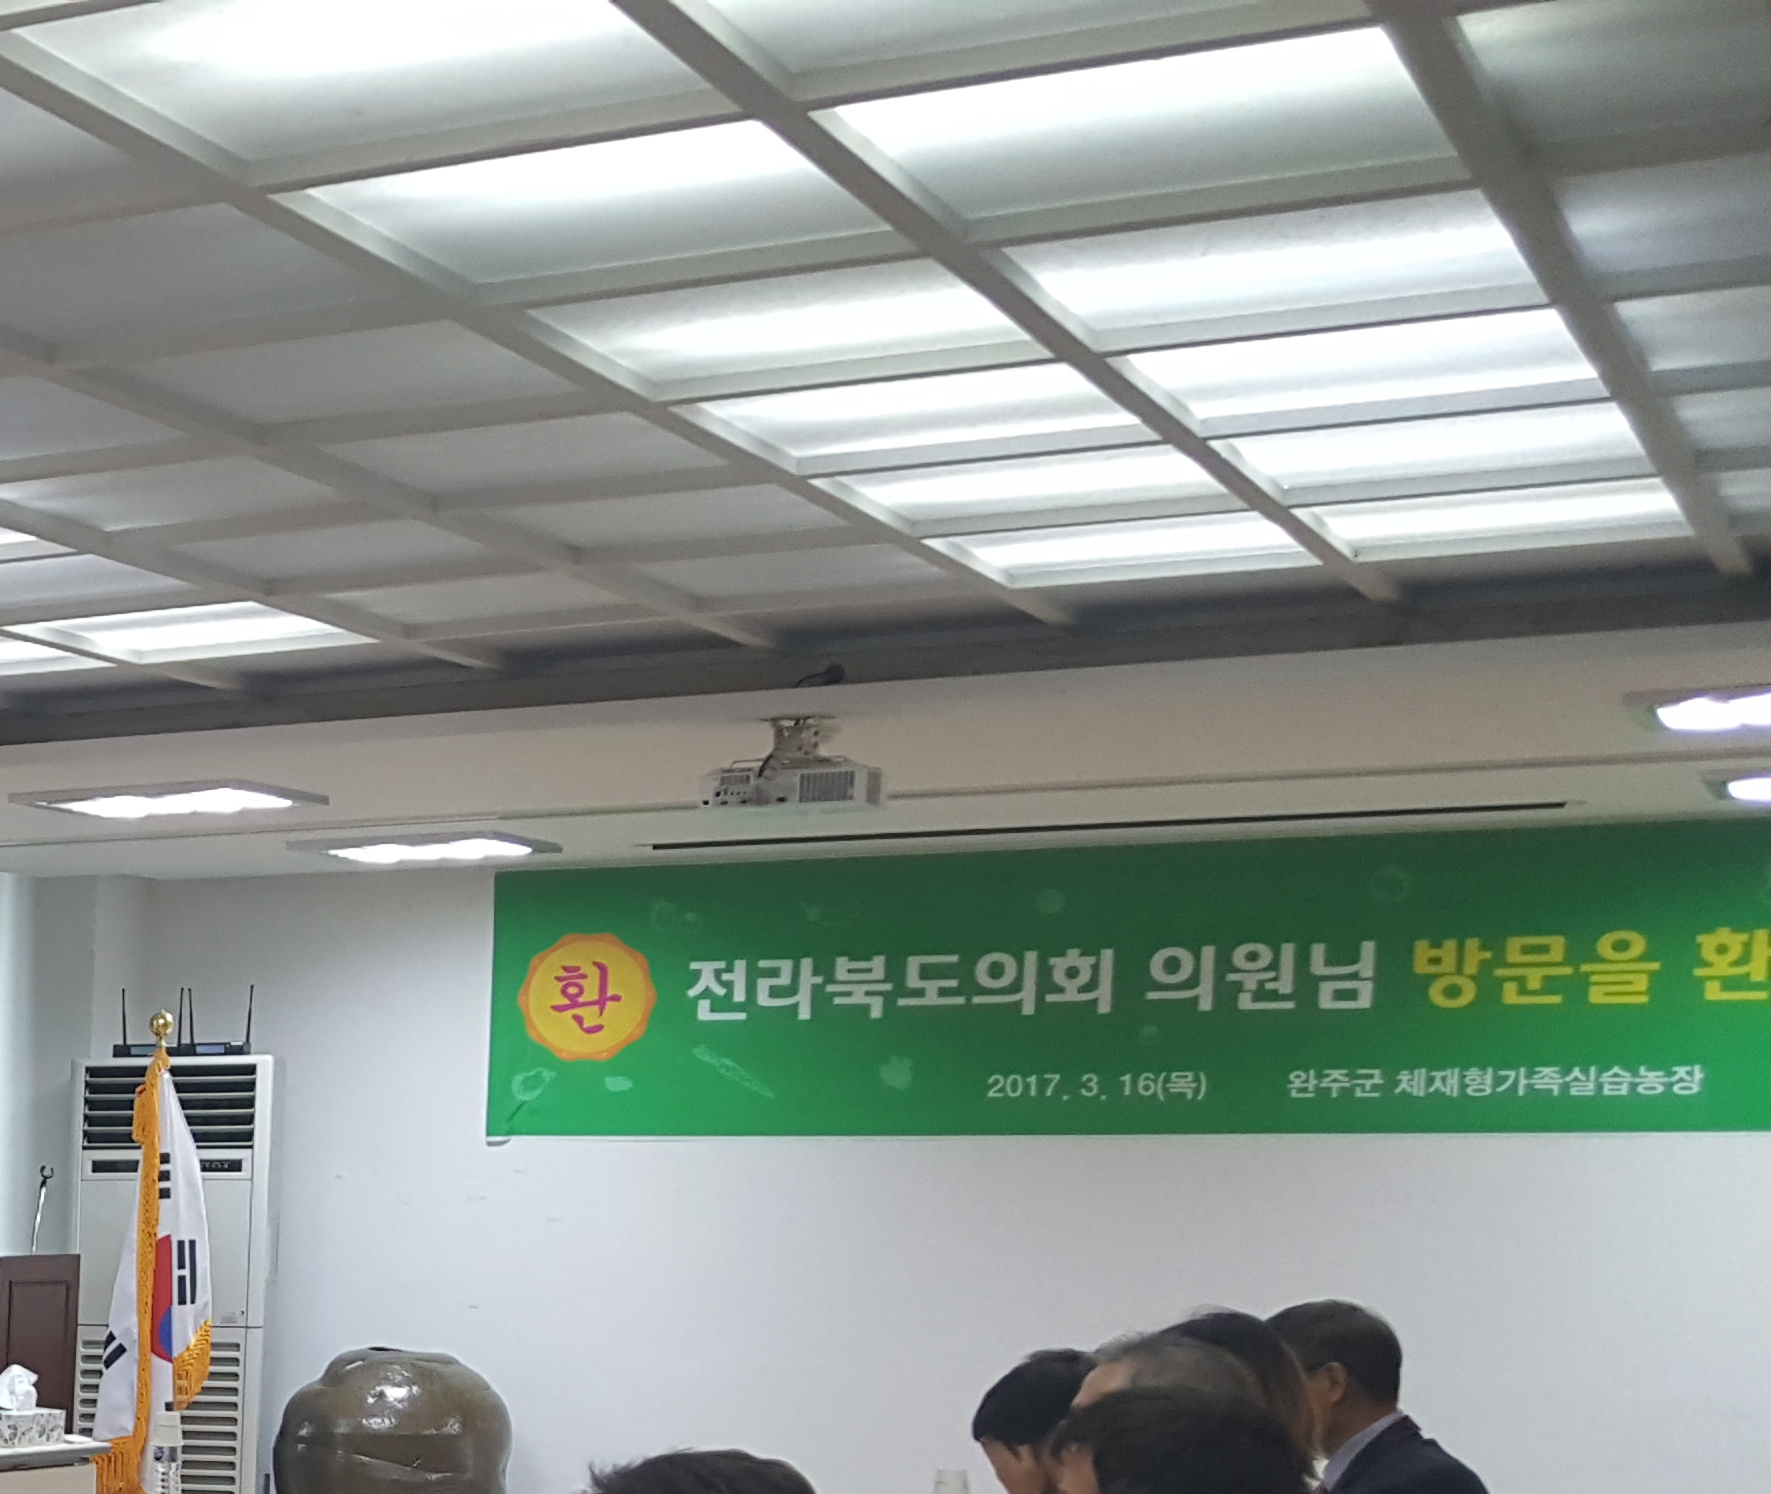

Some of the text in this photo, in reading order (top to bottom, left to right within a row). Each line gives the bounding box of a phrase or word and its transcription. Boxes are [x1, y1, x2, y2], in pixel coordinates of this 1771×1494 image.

[550, 960, 623, 1035] 환
[687, 949, 1113, 1021] 전라북도의회
[1146, 941, 1376, 1011] 의원님
[1413, 930, 1661, 1008] 방문을
[987, 1074, 1069, 1100] 2017.
[1120, 1072, 1206, 1101] 16(목)
[1287, 1069, 1384, 1098] 완주군
[1394, 1065, 1705, 1097] 체재형가족실습농장
